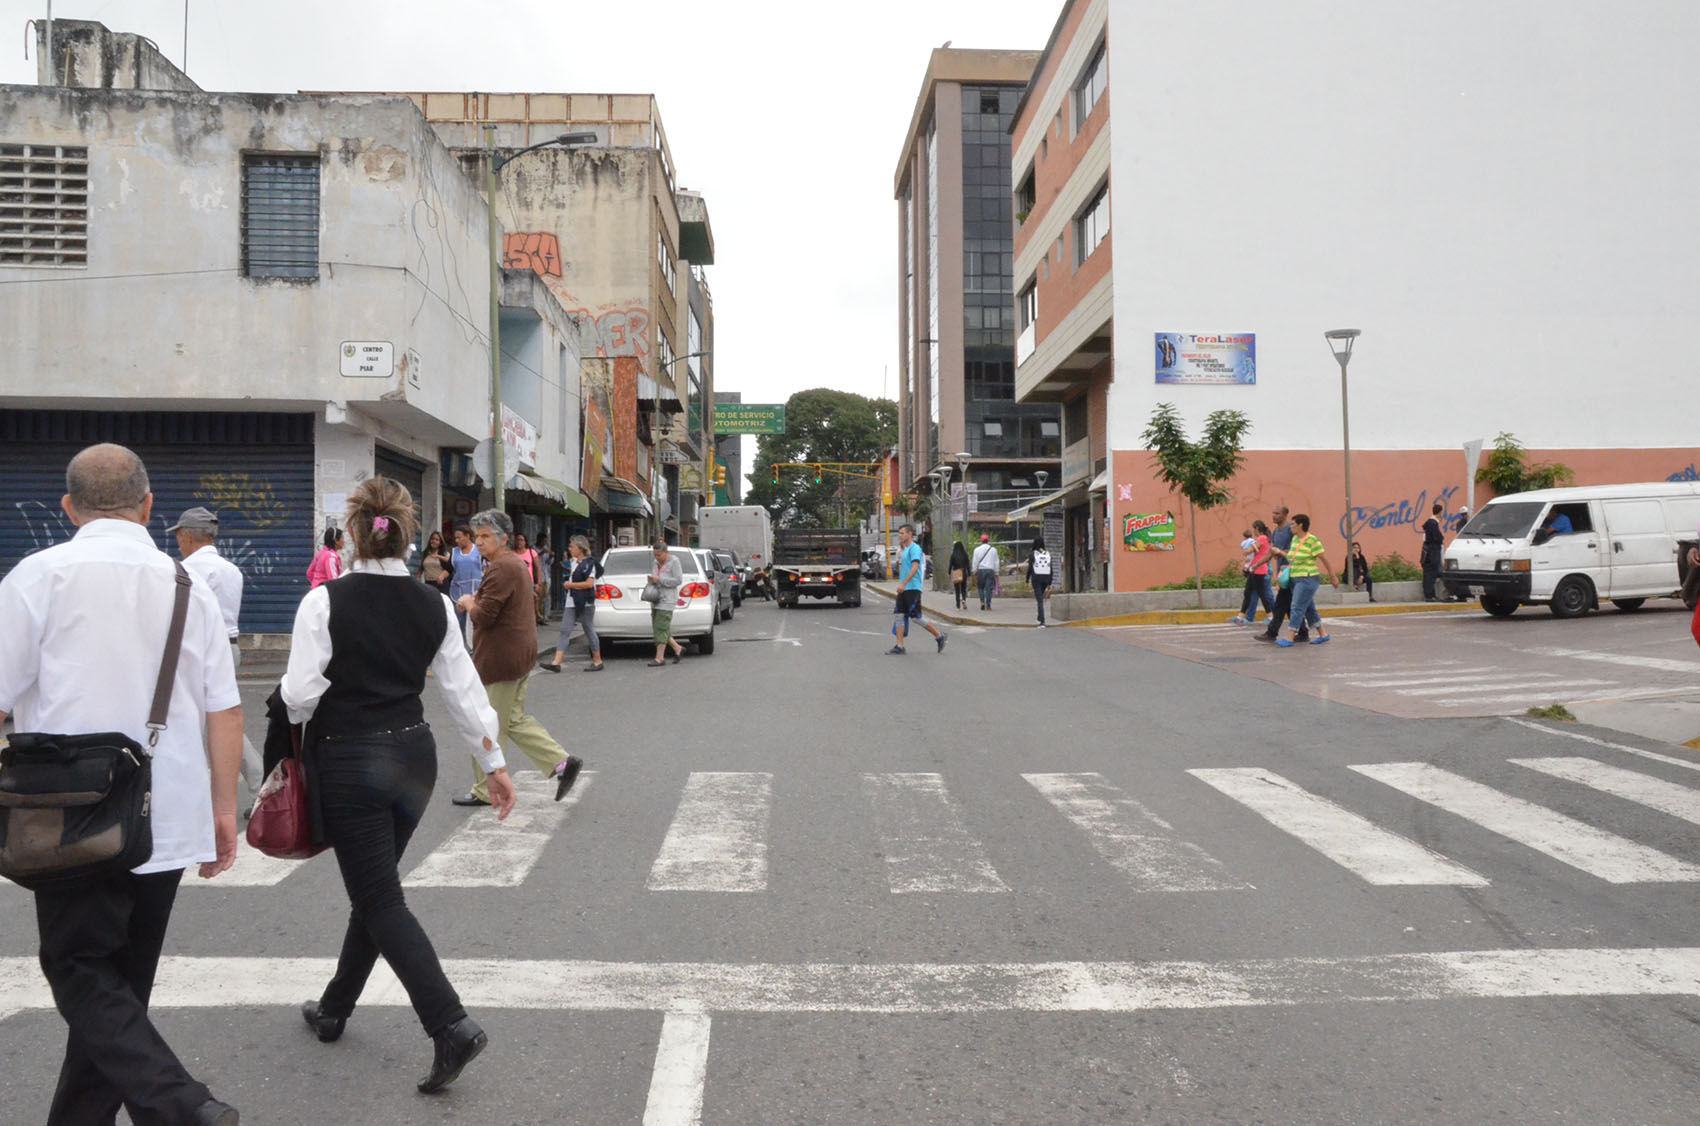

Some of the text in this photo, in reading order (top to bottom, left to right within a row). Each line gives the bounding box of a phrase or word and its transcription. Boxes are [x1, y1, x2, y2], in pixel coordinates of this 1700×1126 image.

[1189, 335, 1252, 344] TeraLaser
[728, 411, 737, 419] DE
[740, 411, 775, 419] SERVICIO
[1126, 514, 1168, 536] FRAPPE
